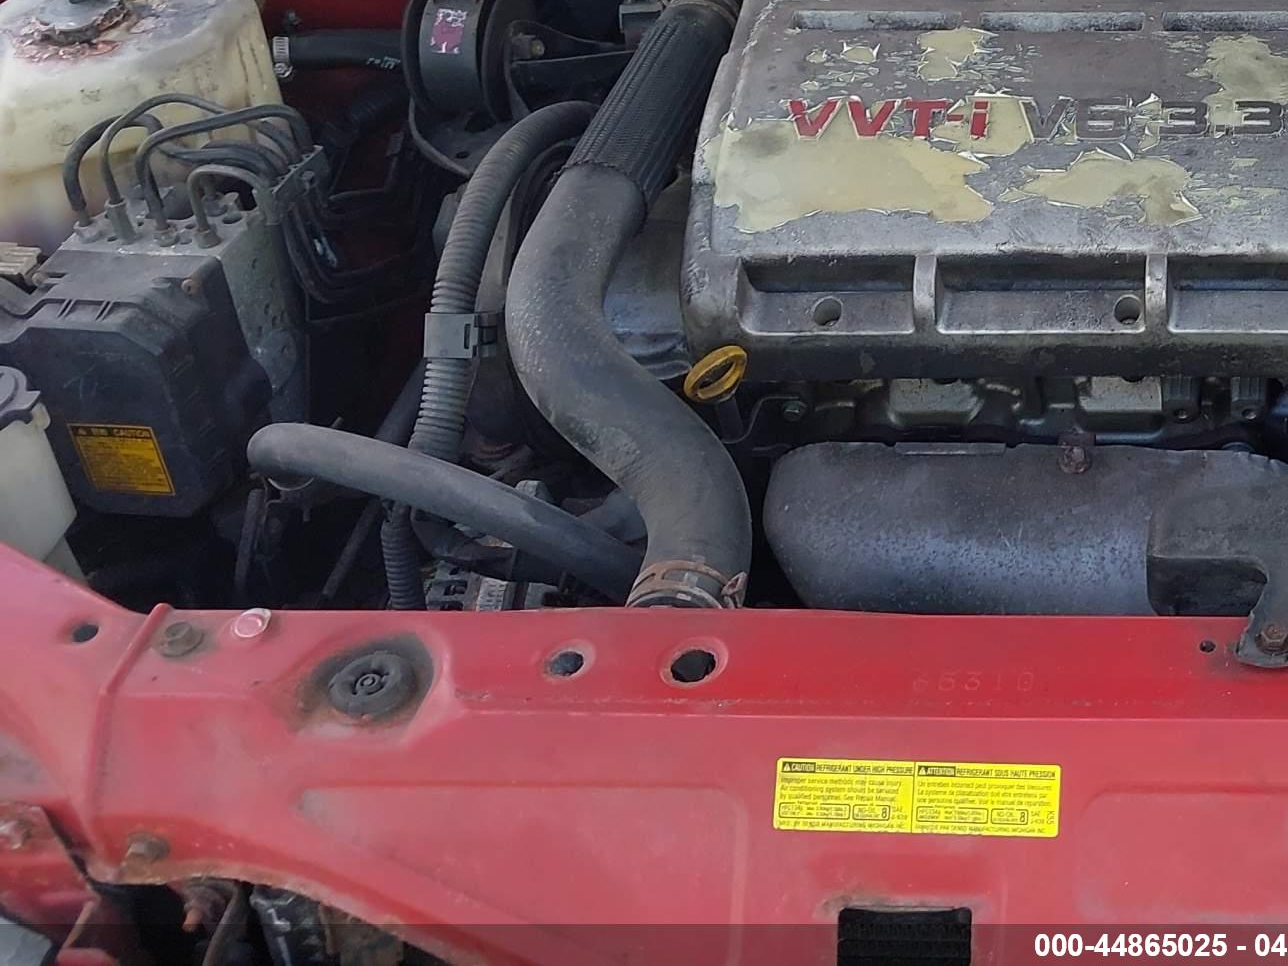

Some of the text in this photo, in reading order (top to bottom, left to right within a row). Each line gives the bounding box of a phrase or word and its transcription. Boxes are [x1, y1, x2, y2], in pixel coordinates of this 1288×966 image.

[787, 95, 1286, 142] VVT-i V6 3.3
[791, 763, 815, 772] CAUTION
[881, 807, 888, 819] 8
[1020, 811, 1026, 823] 8
